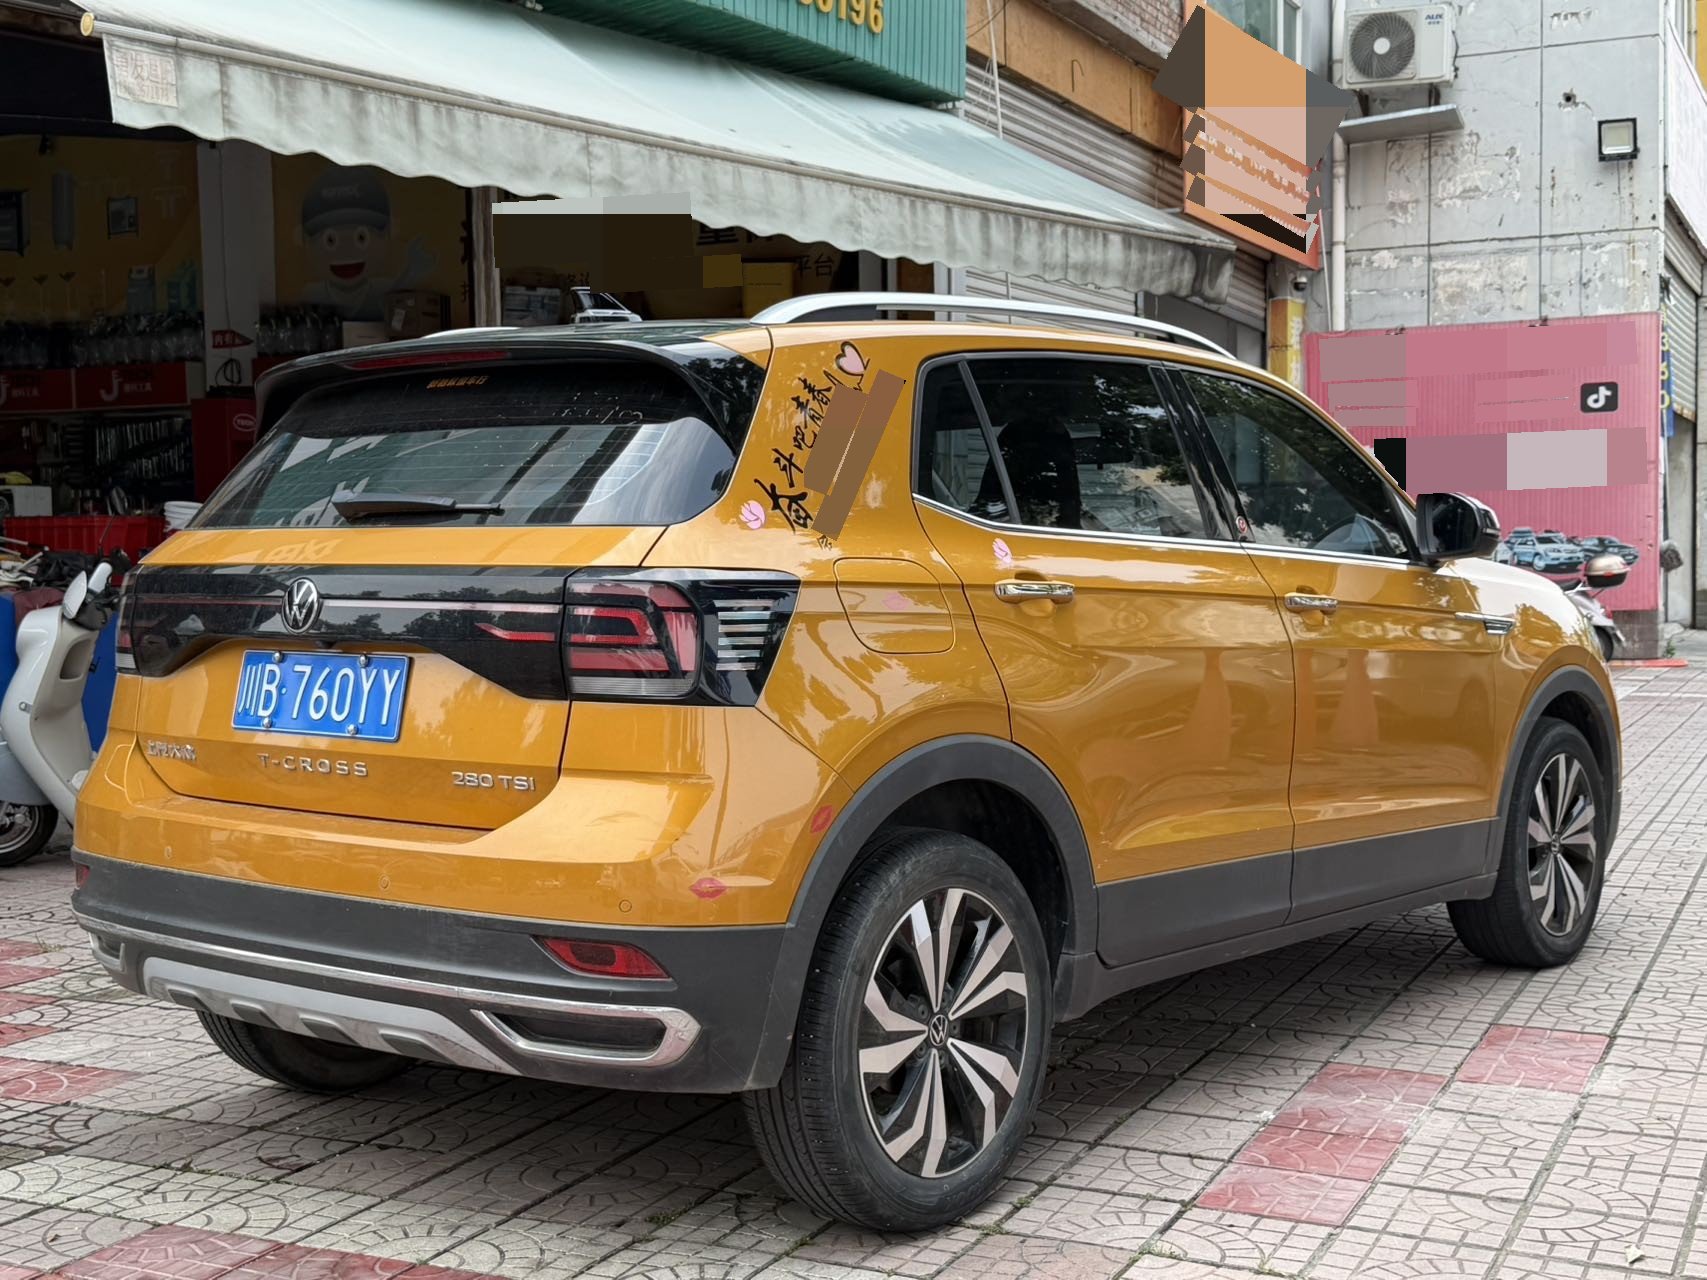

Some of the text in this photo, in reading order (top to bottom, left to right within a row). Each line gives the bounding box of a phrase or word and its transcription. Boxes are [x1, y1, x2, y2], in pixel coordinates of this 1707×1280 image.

[238, 663, 401, 726] 川B·760YY
[257, 753, 369, 777] T-CROSS
[450, 771, 536, 791] 280 TSI
